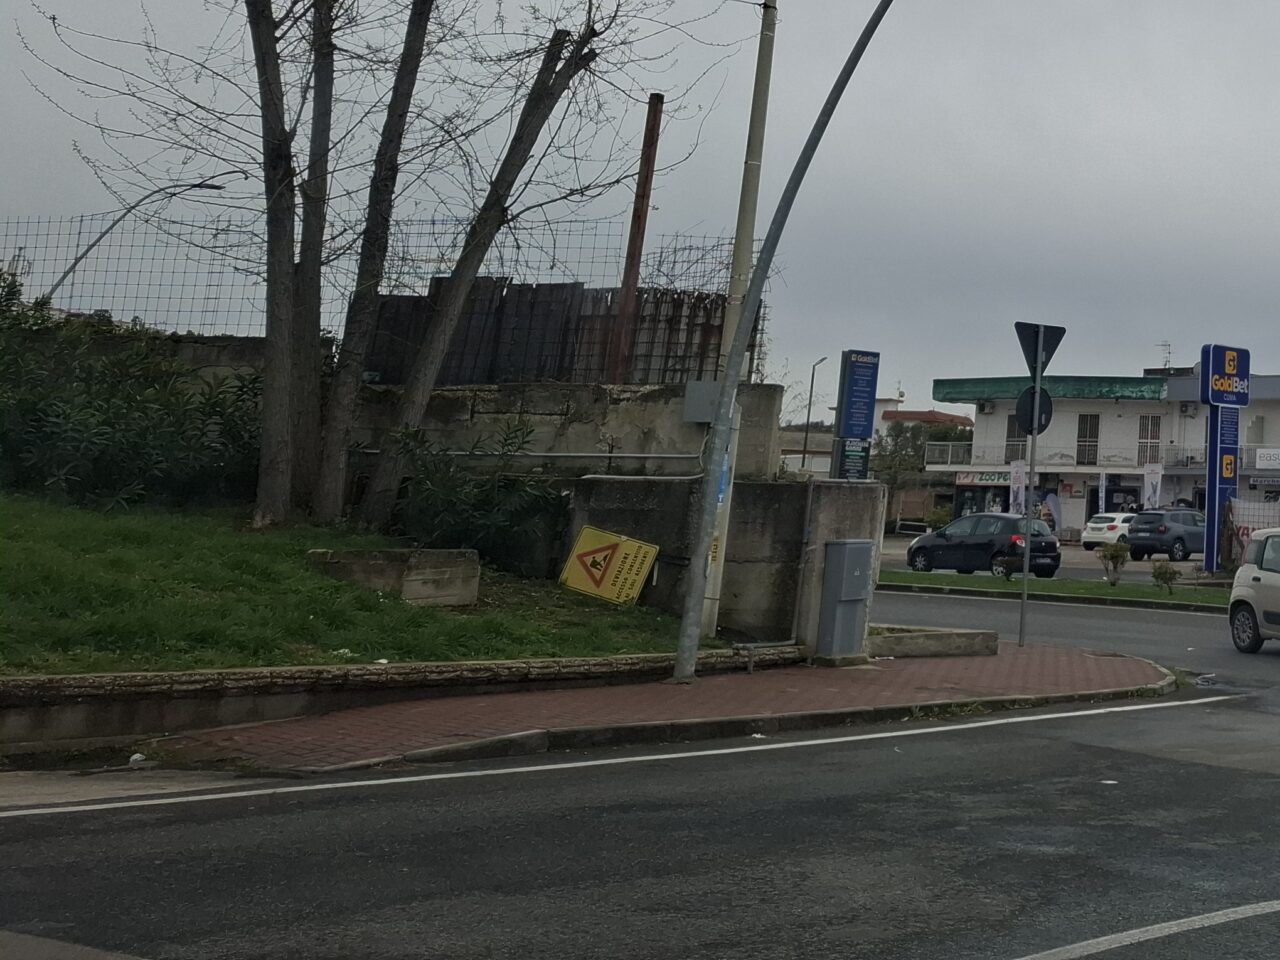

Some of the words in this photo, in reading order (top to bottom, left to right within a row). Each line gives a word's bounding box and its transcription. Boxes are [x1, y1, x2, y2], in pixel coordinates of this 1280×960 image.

[1212, 375, 1248, 393] GoldBet
[611, 552, 630, 587] DEVIAZIONE
[616, 578, 628, 599] ACCESSO
